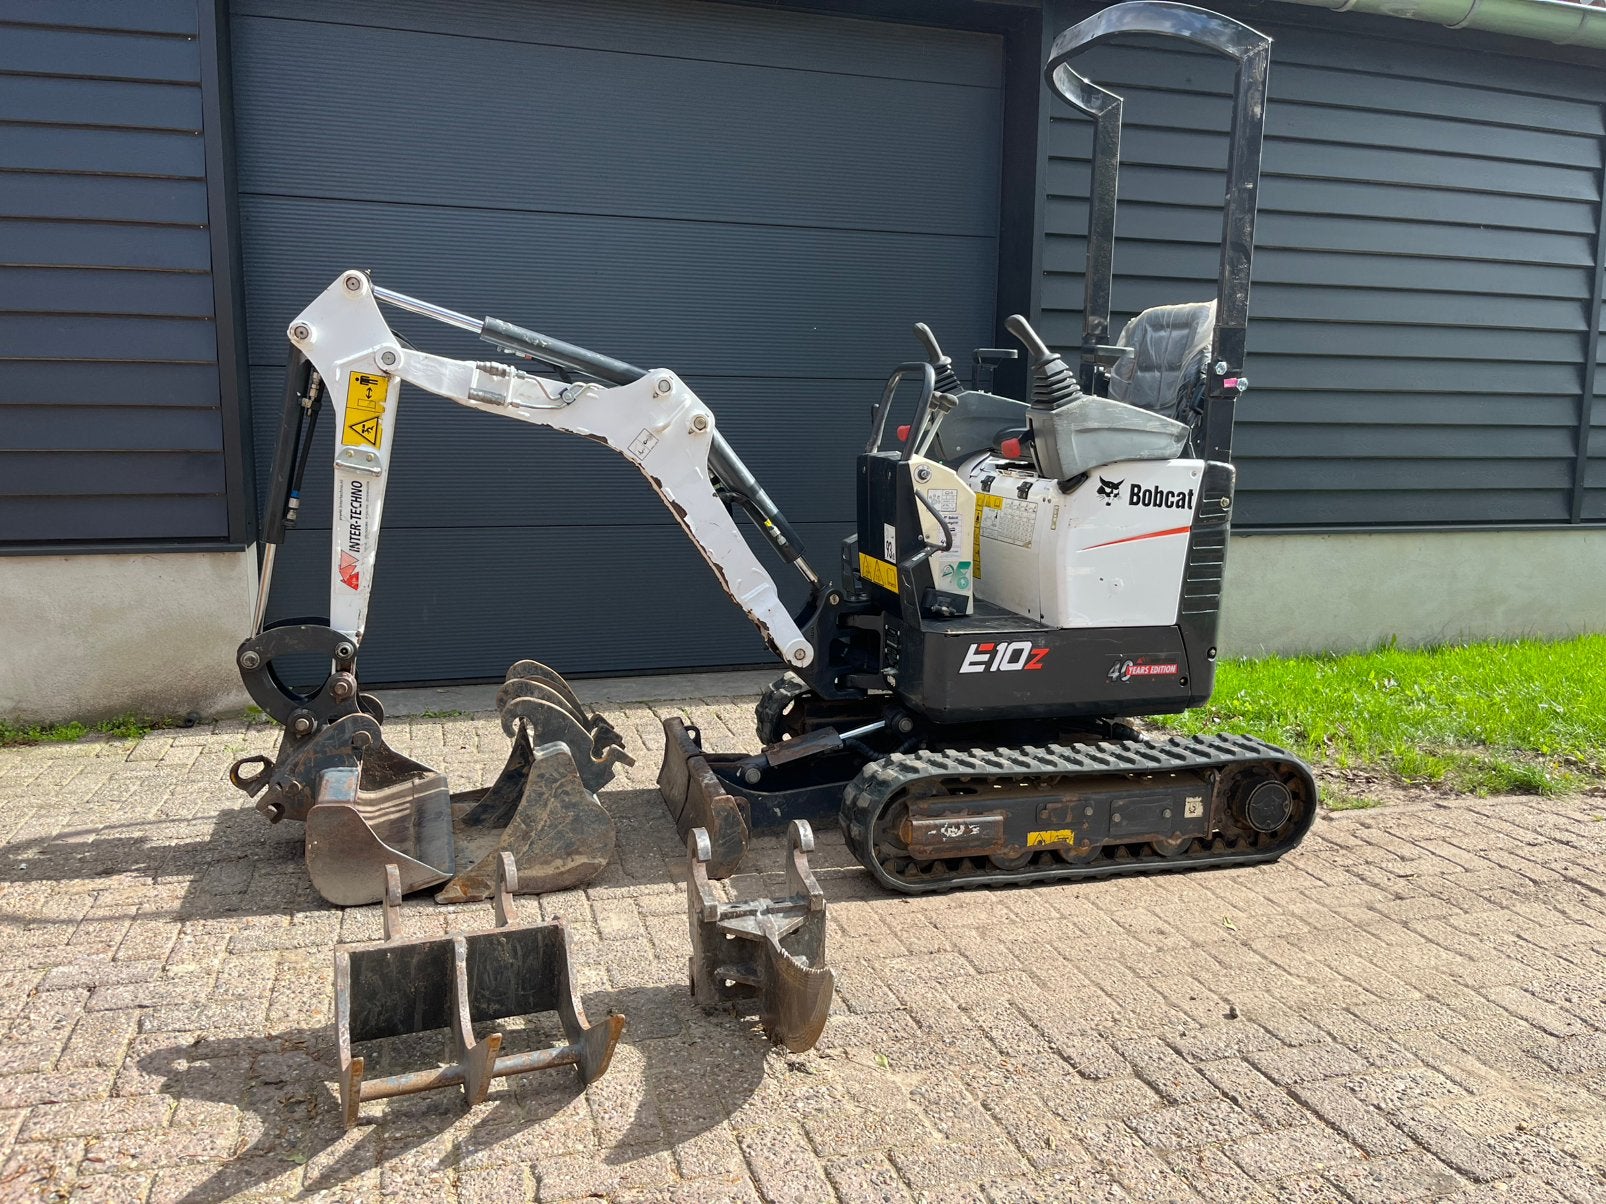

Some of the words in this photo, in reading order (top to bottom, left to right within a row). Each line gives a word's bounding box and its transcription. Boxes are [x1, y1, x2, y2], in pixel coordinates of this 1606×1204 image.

[1128, 483, 1194, 510] Bobcat
[349, 480, 363, 552] INTER-TECHNO
[1108, 659, 1134, 681] 40
[1129, 666, 1149, 675] YEARS
[1150, 665, 1177, 674] EDITION
